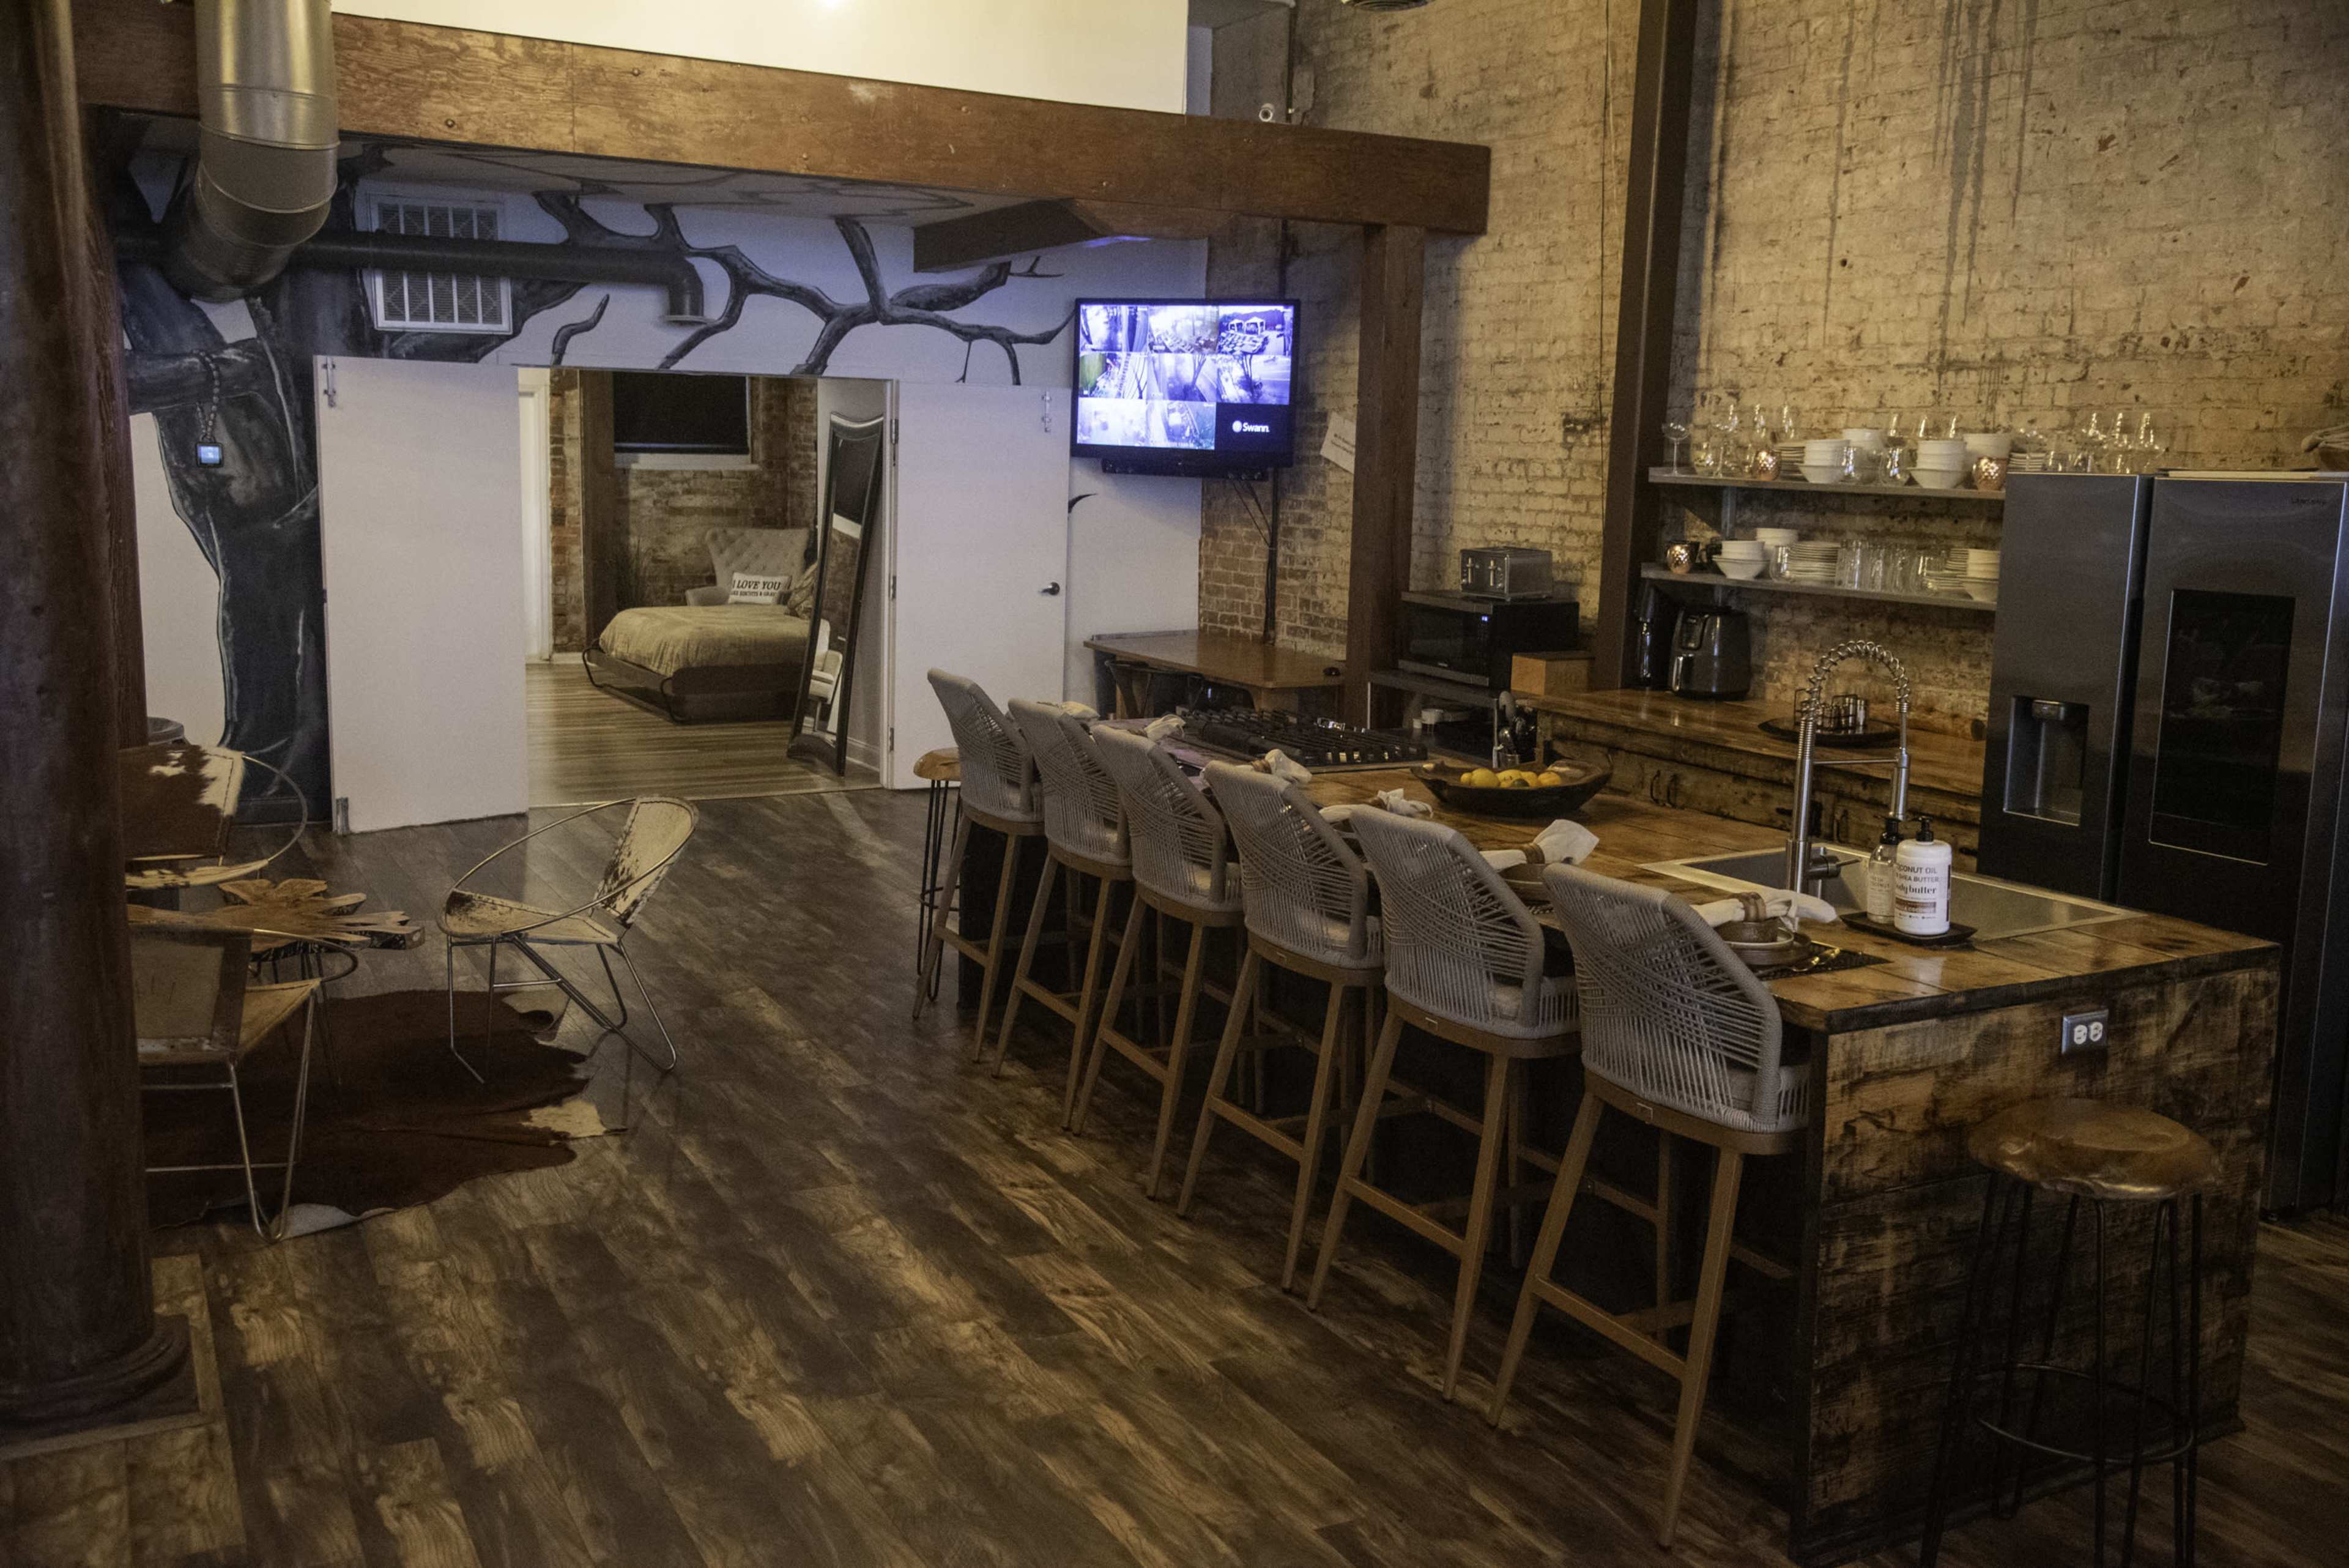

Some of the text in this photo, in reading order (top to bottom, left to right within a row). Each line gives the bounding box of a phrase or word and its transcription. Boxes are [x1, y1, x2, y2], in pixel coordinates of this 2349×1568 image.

[737, 580, 760, 589] LOVE
[762, 581, 781, 590] YOU
[1897, 864, 1924, 874] OCONUT
